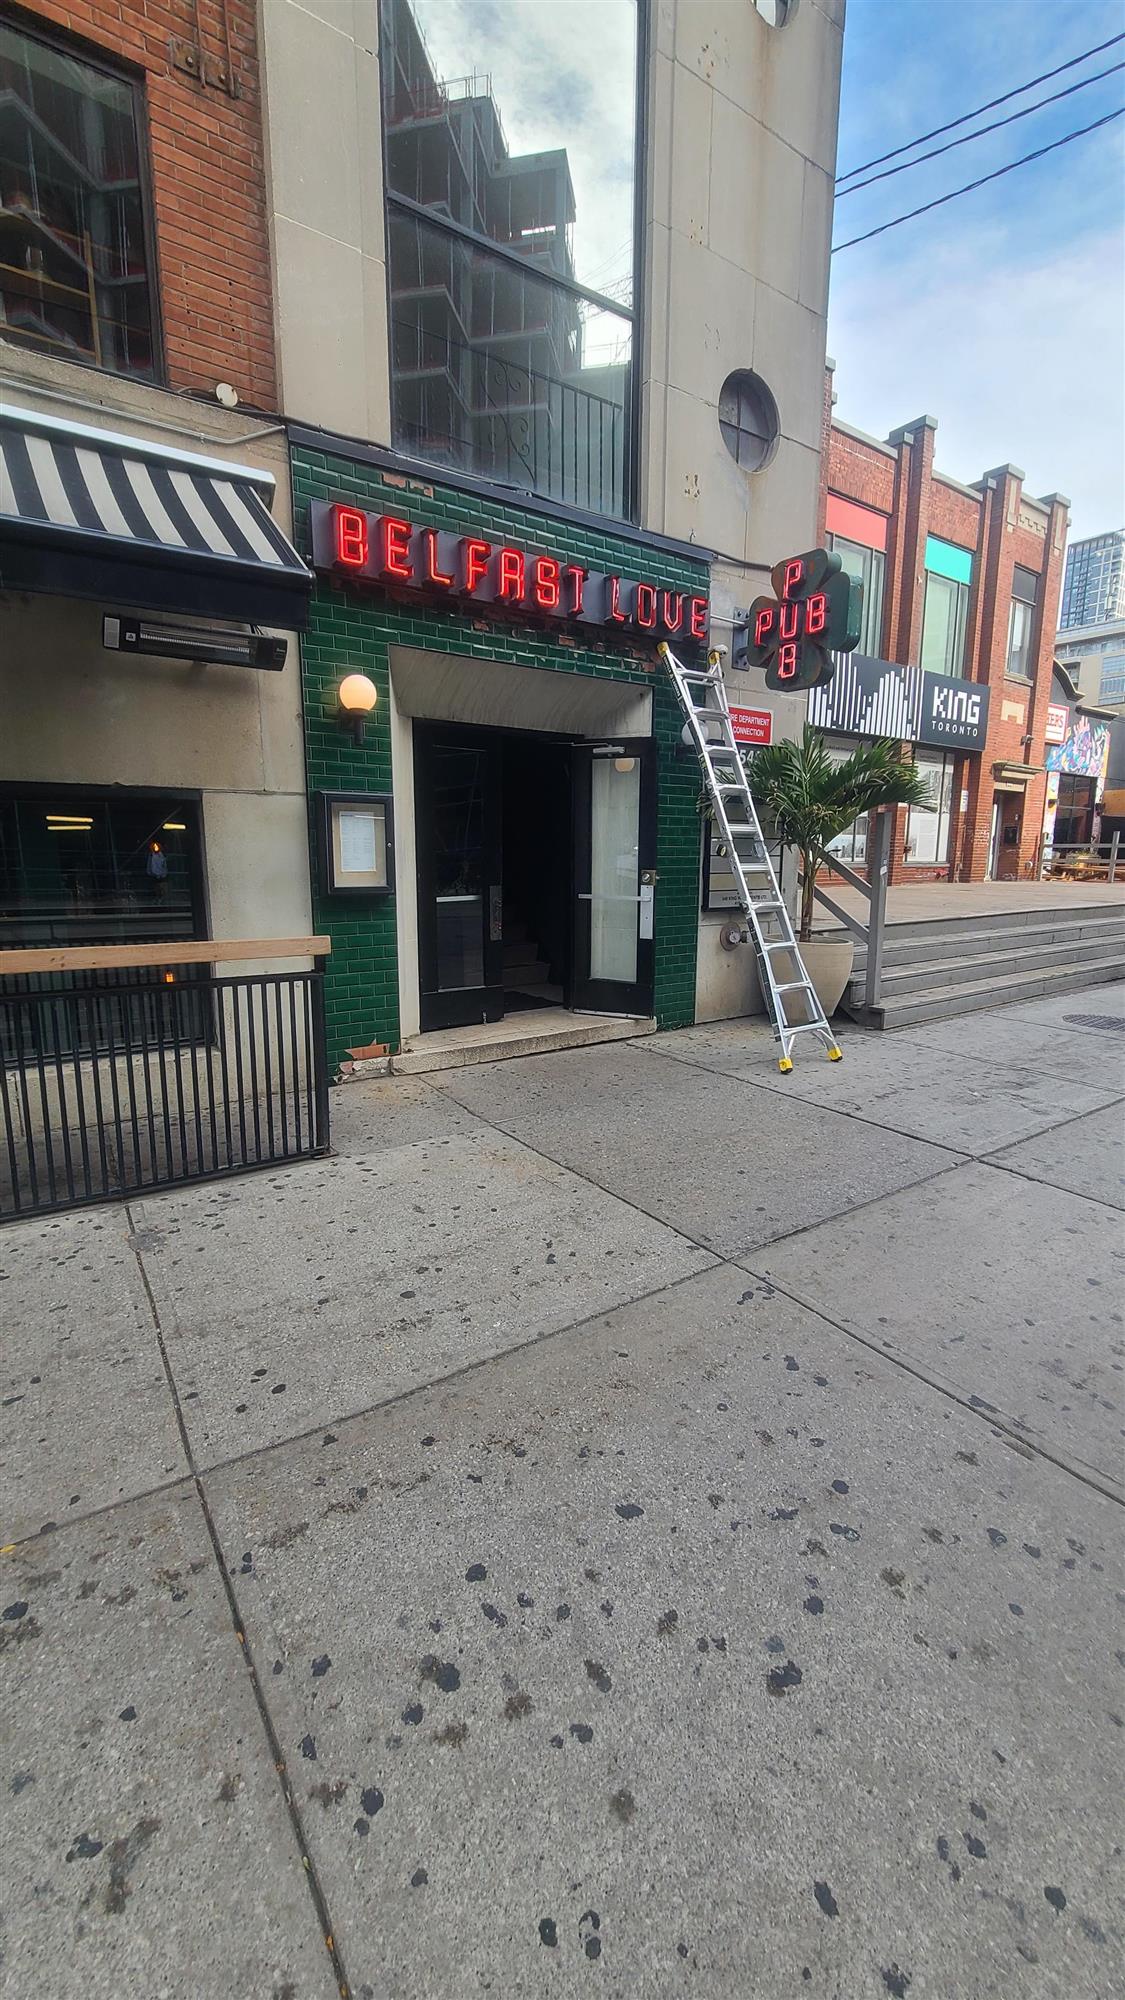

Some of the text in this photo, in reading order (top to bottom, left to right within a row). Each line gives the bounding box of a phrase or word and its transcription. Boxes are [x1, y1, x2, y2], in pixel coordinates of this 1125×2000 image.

[331, 504, 709, 640] BELFAST LOVE
[755, 593, 826, 646] PUB
[778, 559, 803, 679] PUB
[738, 714, 770, 726] DEPARTMENT
[932, 686, 981, 725] KING
[733, 725, 764, 737] CONNECTION
[931, 720, 978, 737] TORONTO
